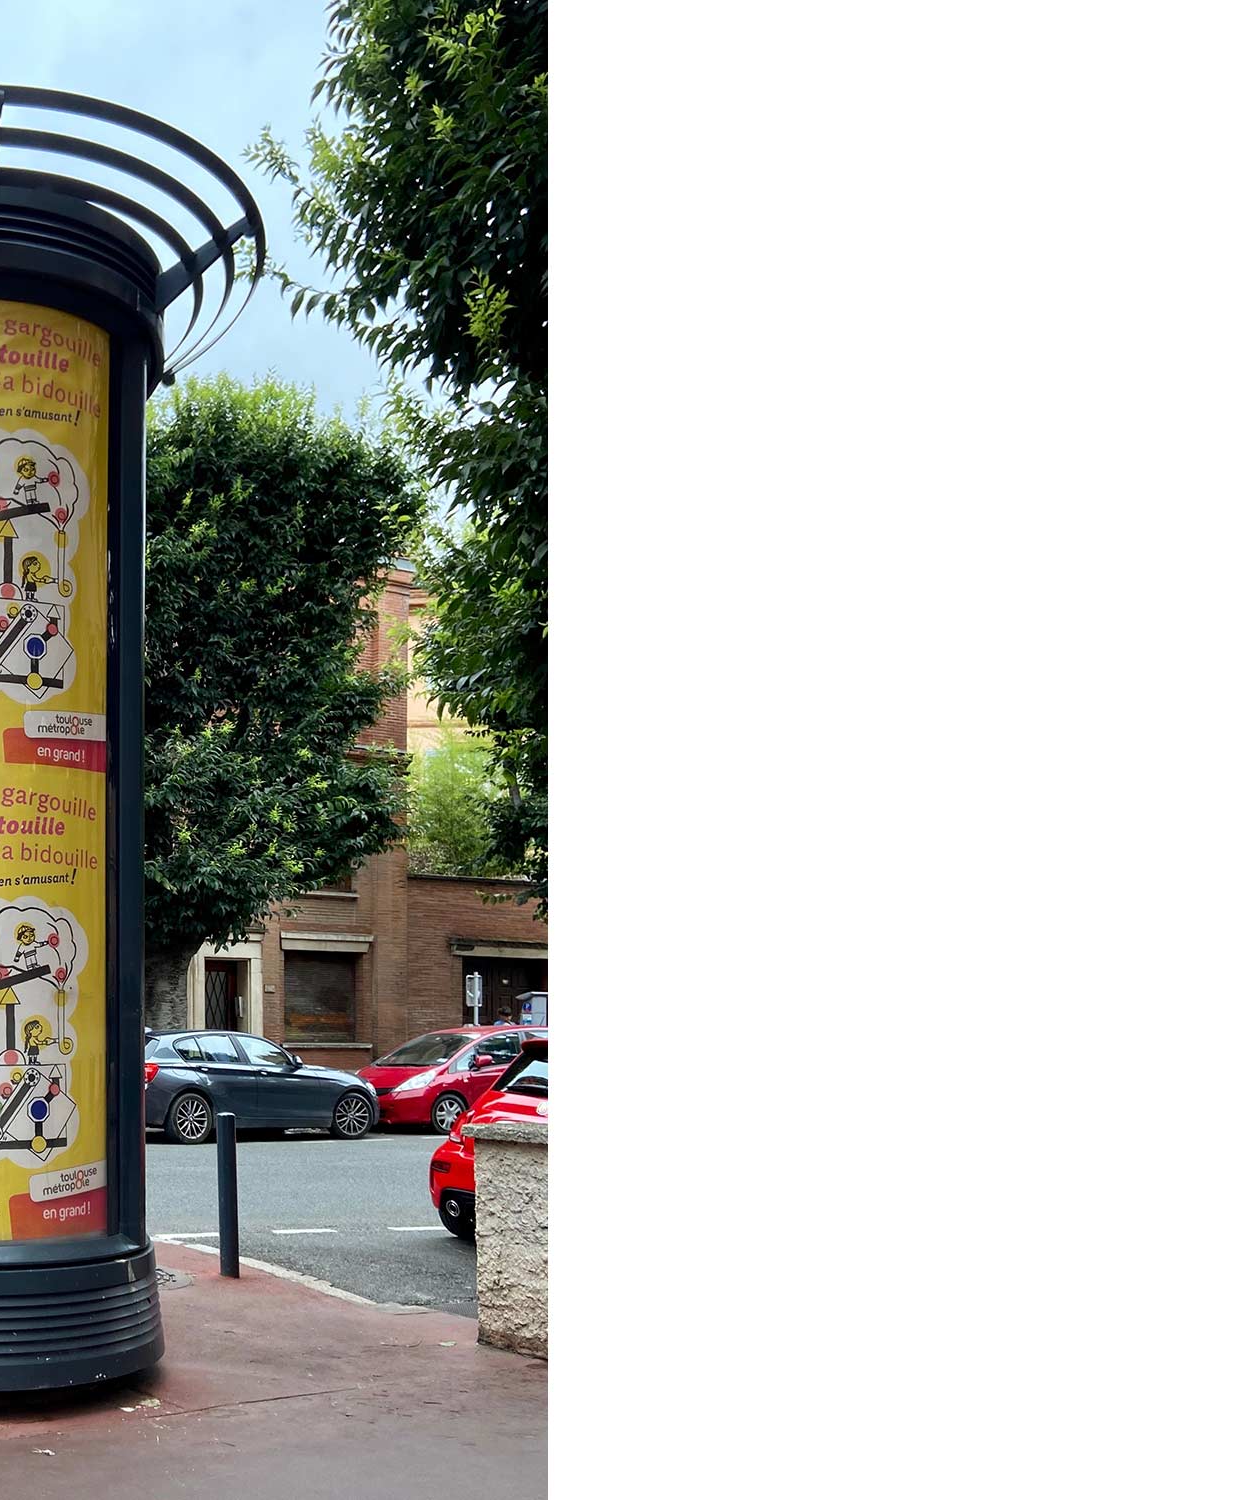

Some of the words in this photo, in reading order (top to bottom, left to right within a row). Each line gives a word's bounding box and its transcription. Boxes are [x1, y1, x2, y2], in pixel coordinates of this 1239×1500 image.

[4, 319, 102, 367] gargouille
[22, 374, 101, 418] bidouille
[56, 714, 93, 727] toulouse
[37, 746, 51, 757] en
[53, 749, 80, 762] grand
[1, 788, 97, 821] gargouille
[21, 842, 98, 870] bidouille
[60, 1167, 97, 1182] toulouse
[43, 1208, 57, 1220] en
[59, 1201, 86, 1221] grand
